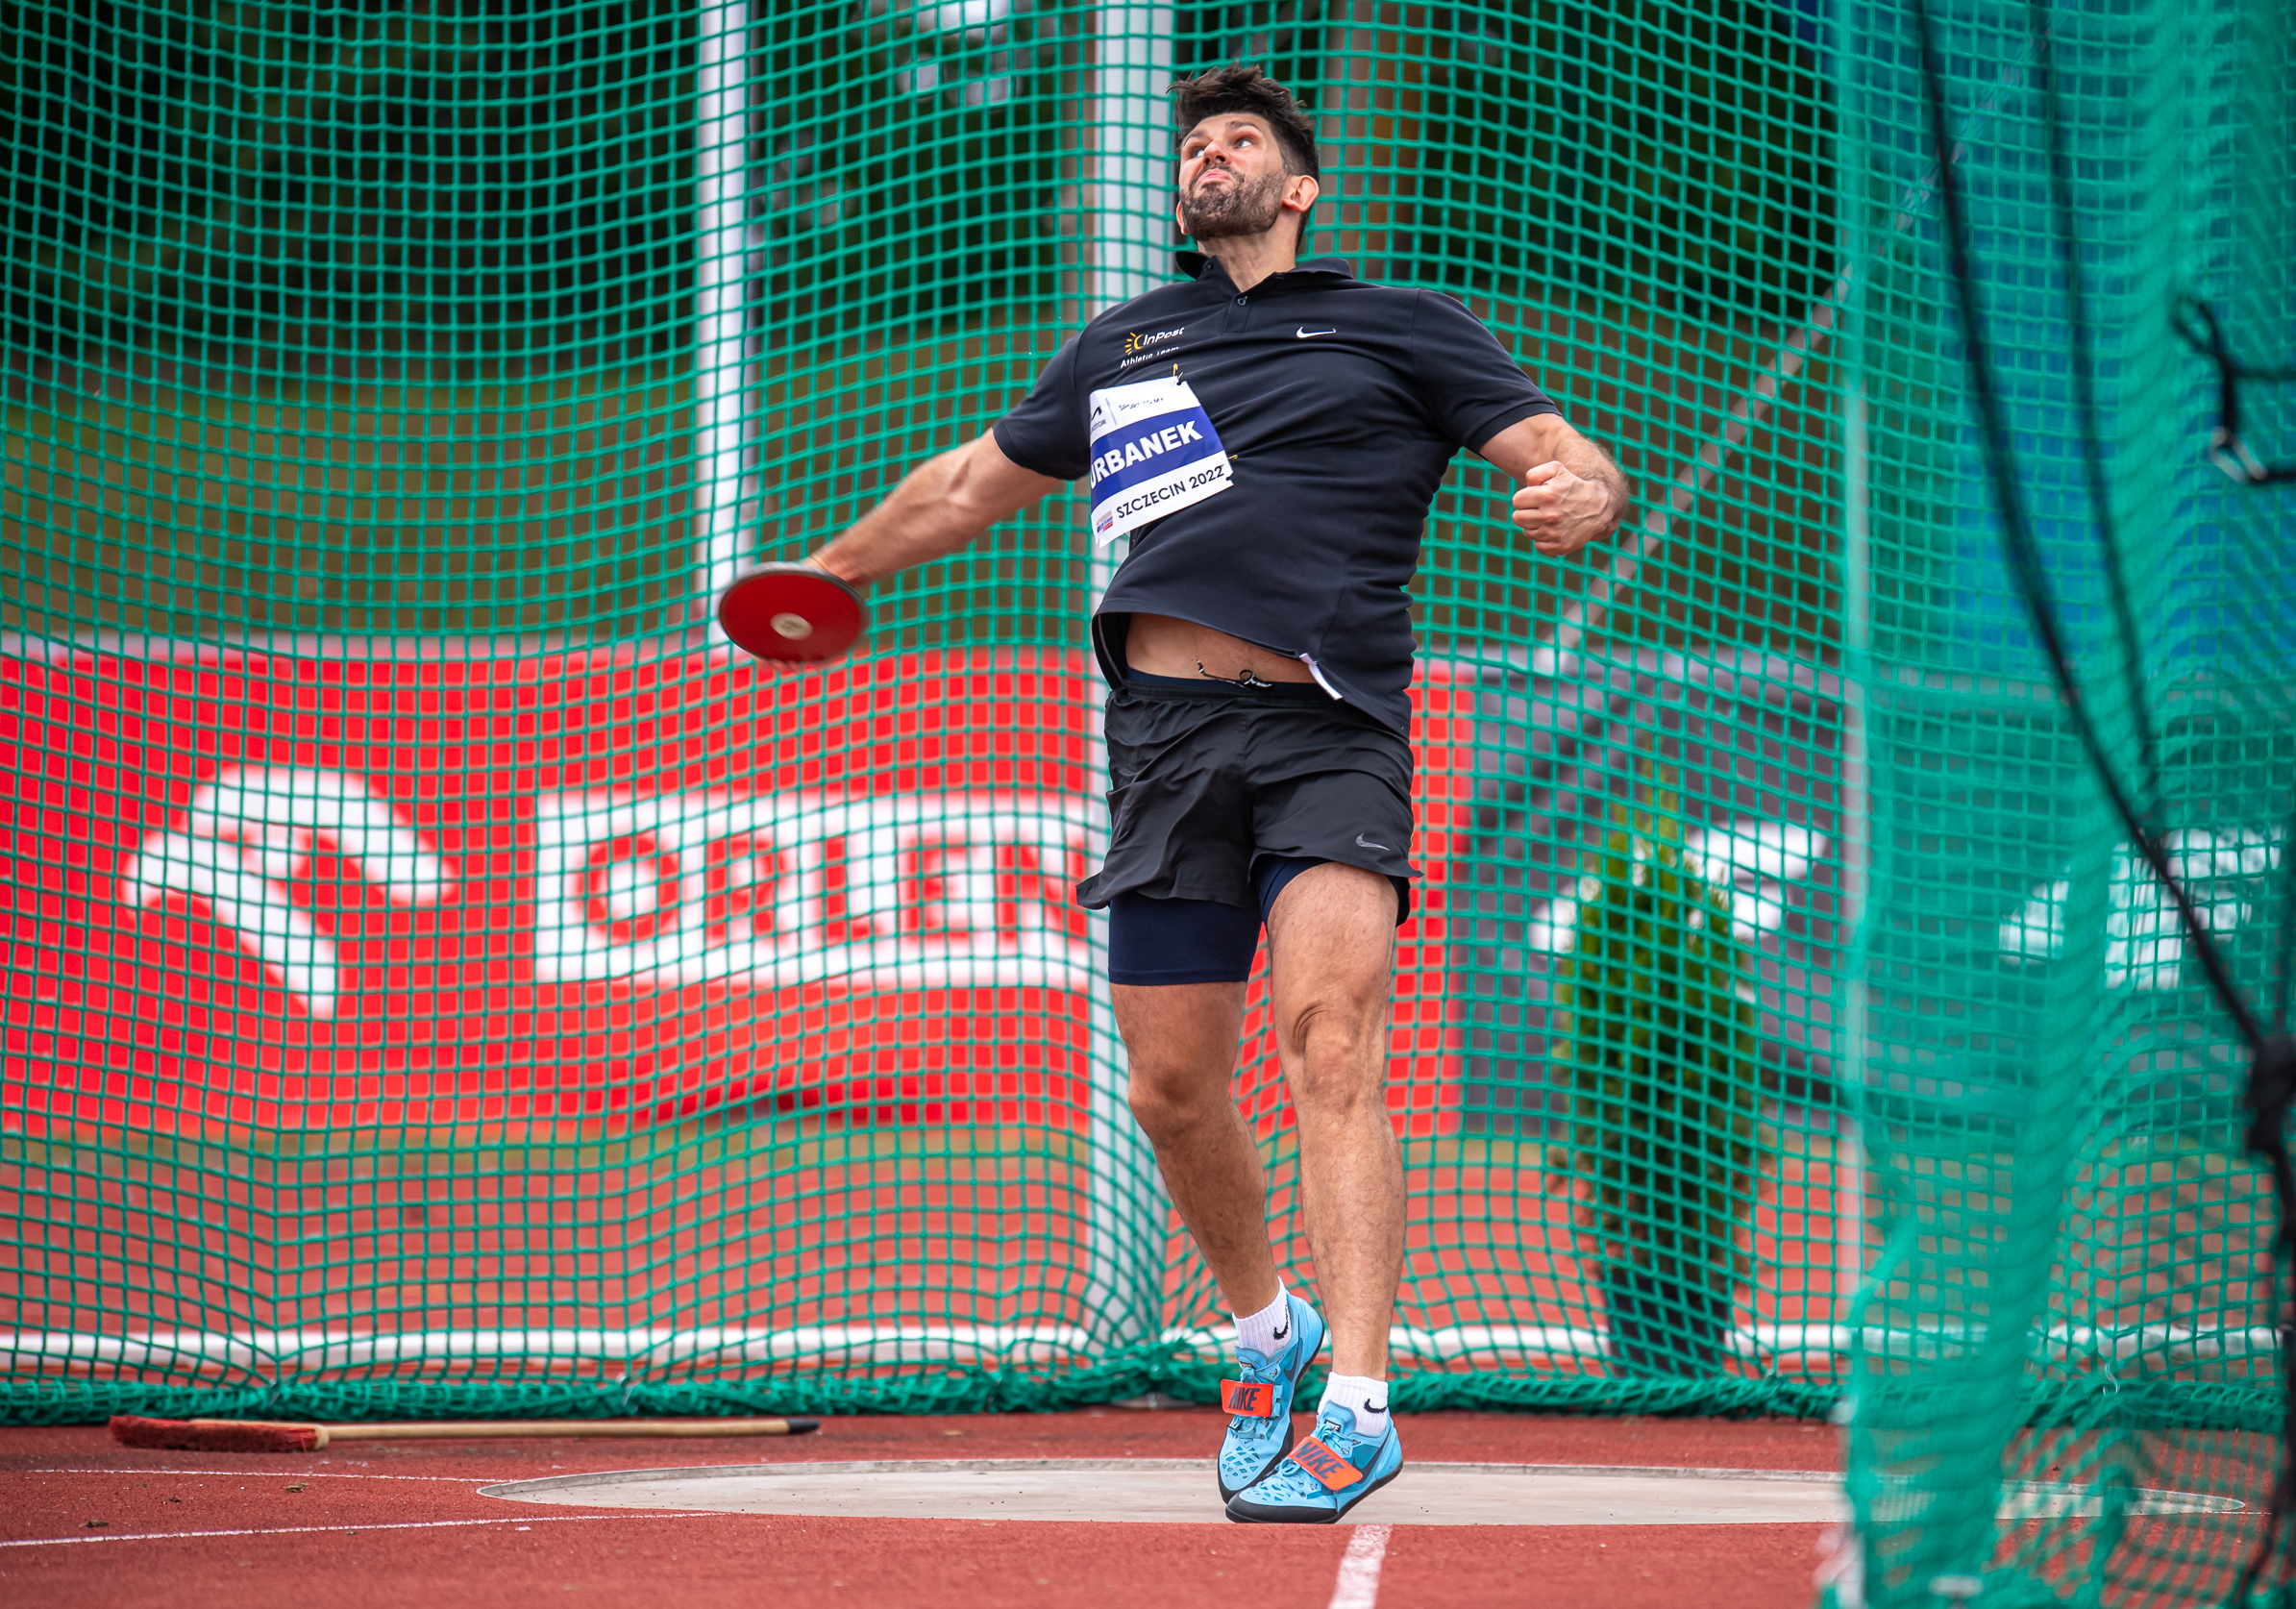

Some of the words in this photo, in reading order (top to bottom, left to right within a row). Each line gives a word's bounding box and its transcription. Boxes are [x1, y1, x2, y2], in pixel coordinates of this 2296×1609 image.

[1143, 327, 1185, 346] InPost
[1116, 481, 1187, 519] SZCZECIN
[1189, 465, 1225, 489] 2022
[584, 832, 1090, 944] ORLEN
[1228, 1387, 1261, 1411] NIKE
[1296, 1443, 1345, 1479] NIKE
